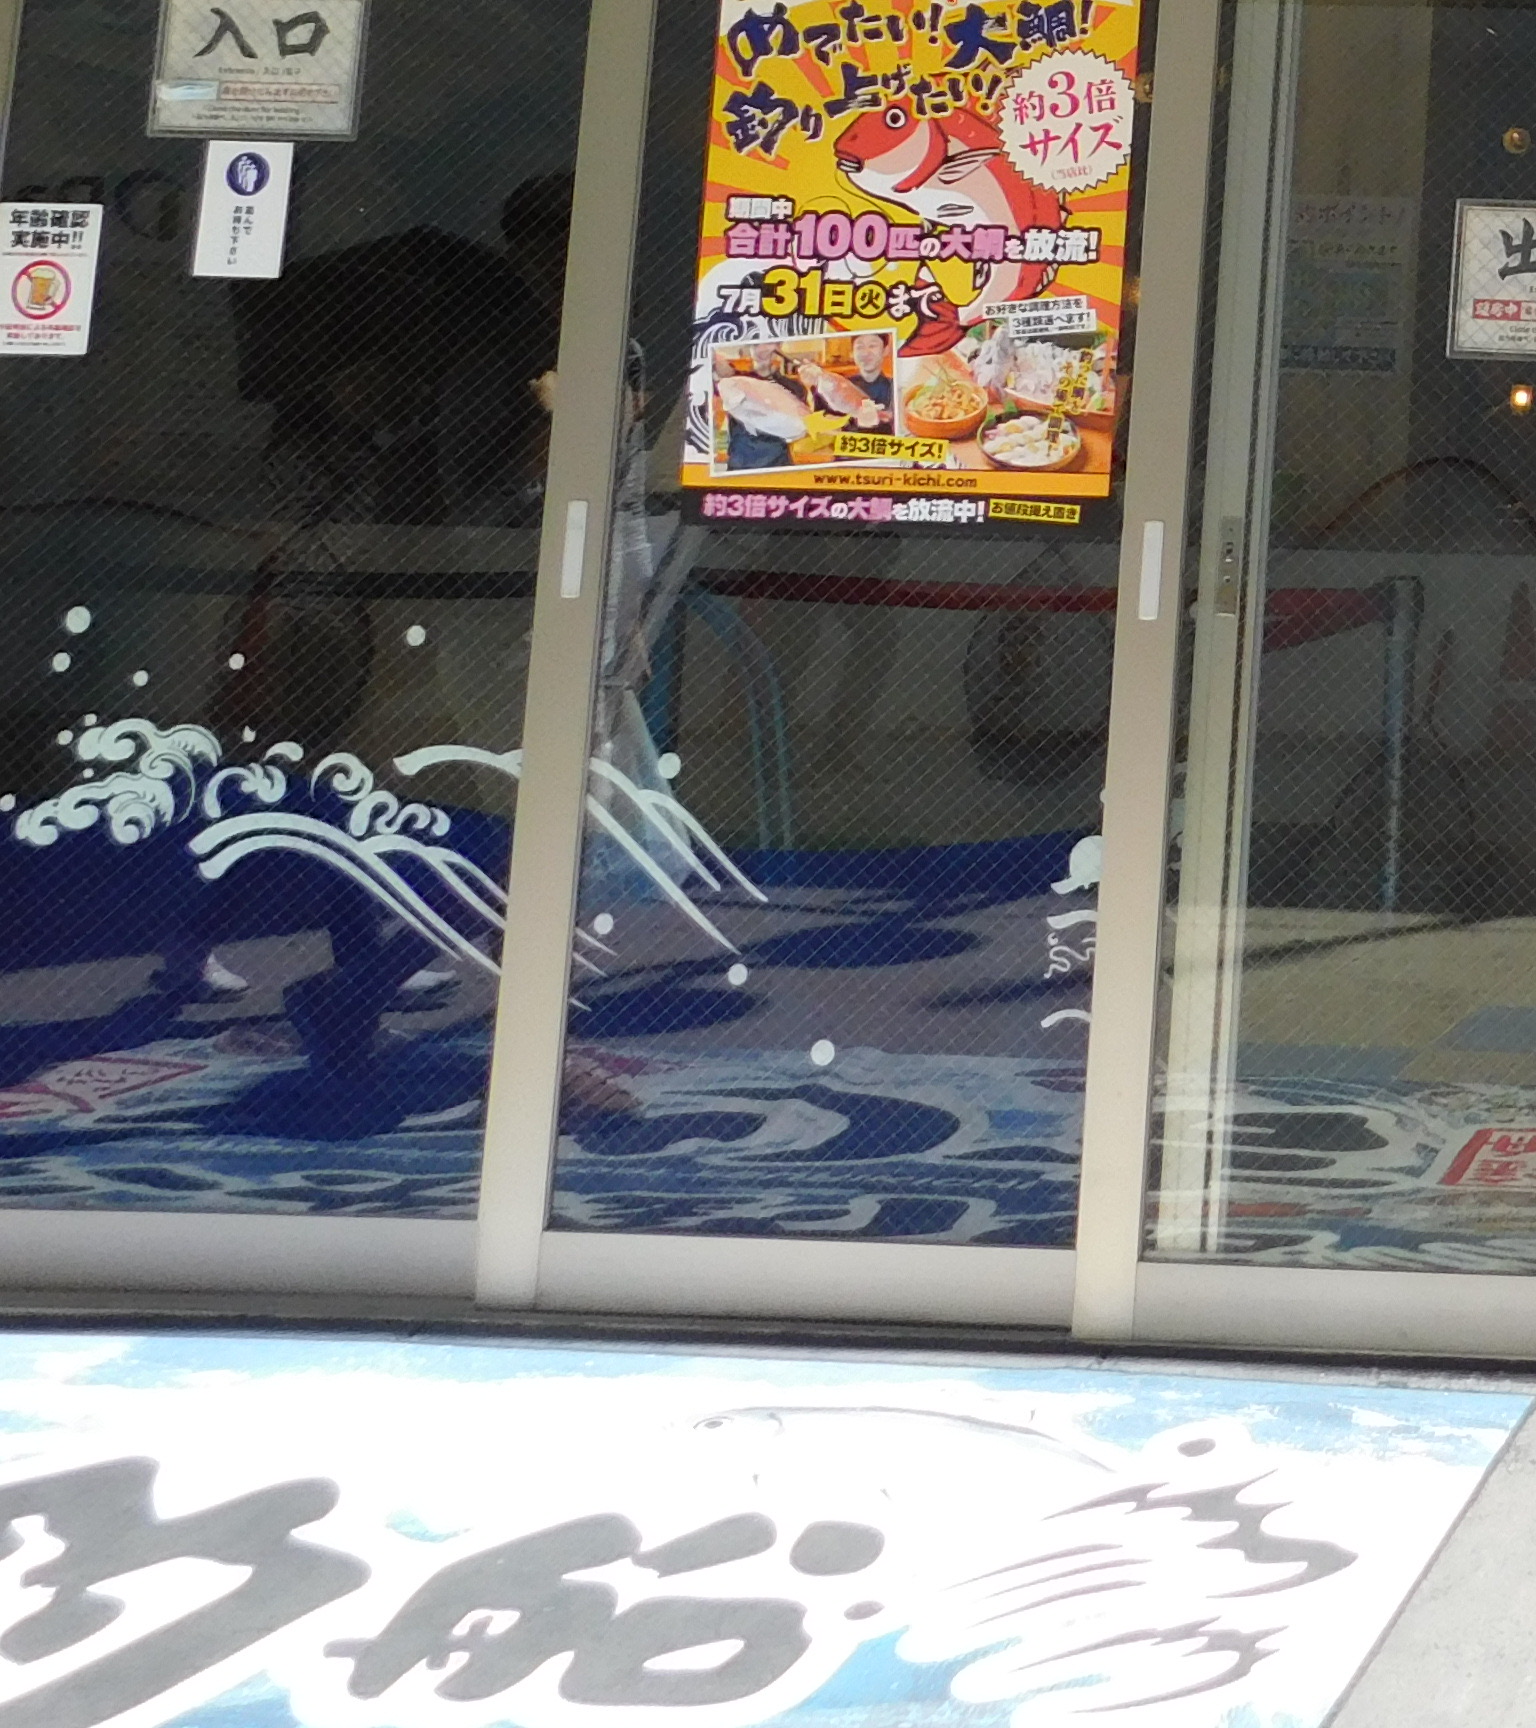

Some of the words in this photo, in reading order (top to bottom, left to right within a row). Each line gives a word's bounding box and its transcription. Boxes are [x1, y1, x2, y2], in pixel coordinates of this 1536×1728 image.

[193, 7, 330, 59] 入口
[1012, 71, 1117, 125] 約3倍
[1019, 115, 1124, 167] サイズ
[813, 472, 978, 489] www.tsuri-kichi.com
